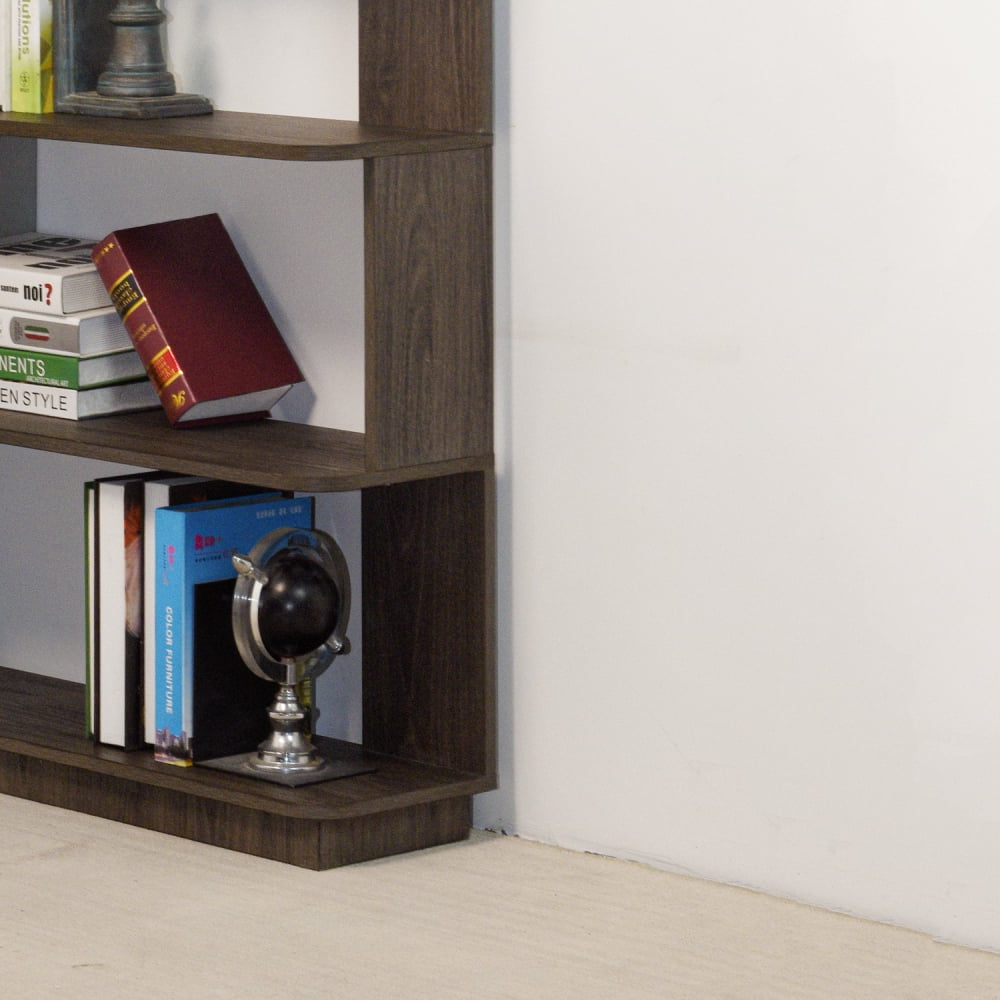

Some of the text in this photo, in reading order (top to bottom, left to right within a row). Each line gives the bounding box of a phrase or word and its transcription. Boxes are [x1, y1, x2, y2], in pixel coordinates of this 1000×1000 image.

[24, 255, 93, 270] no
[23, 283, 53, 306] noi?
[23, 390, 68, 411] STYLE
